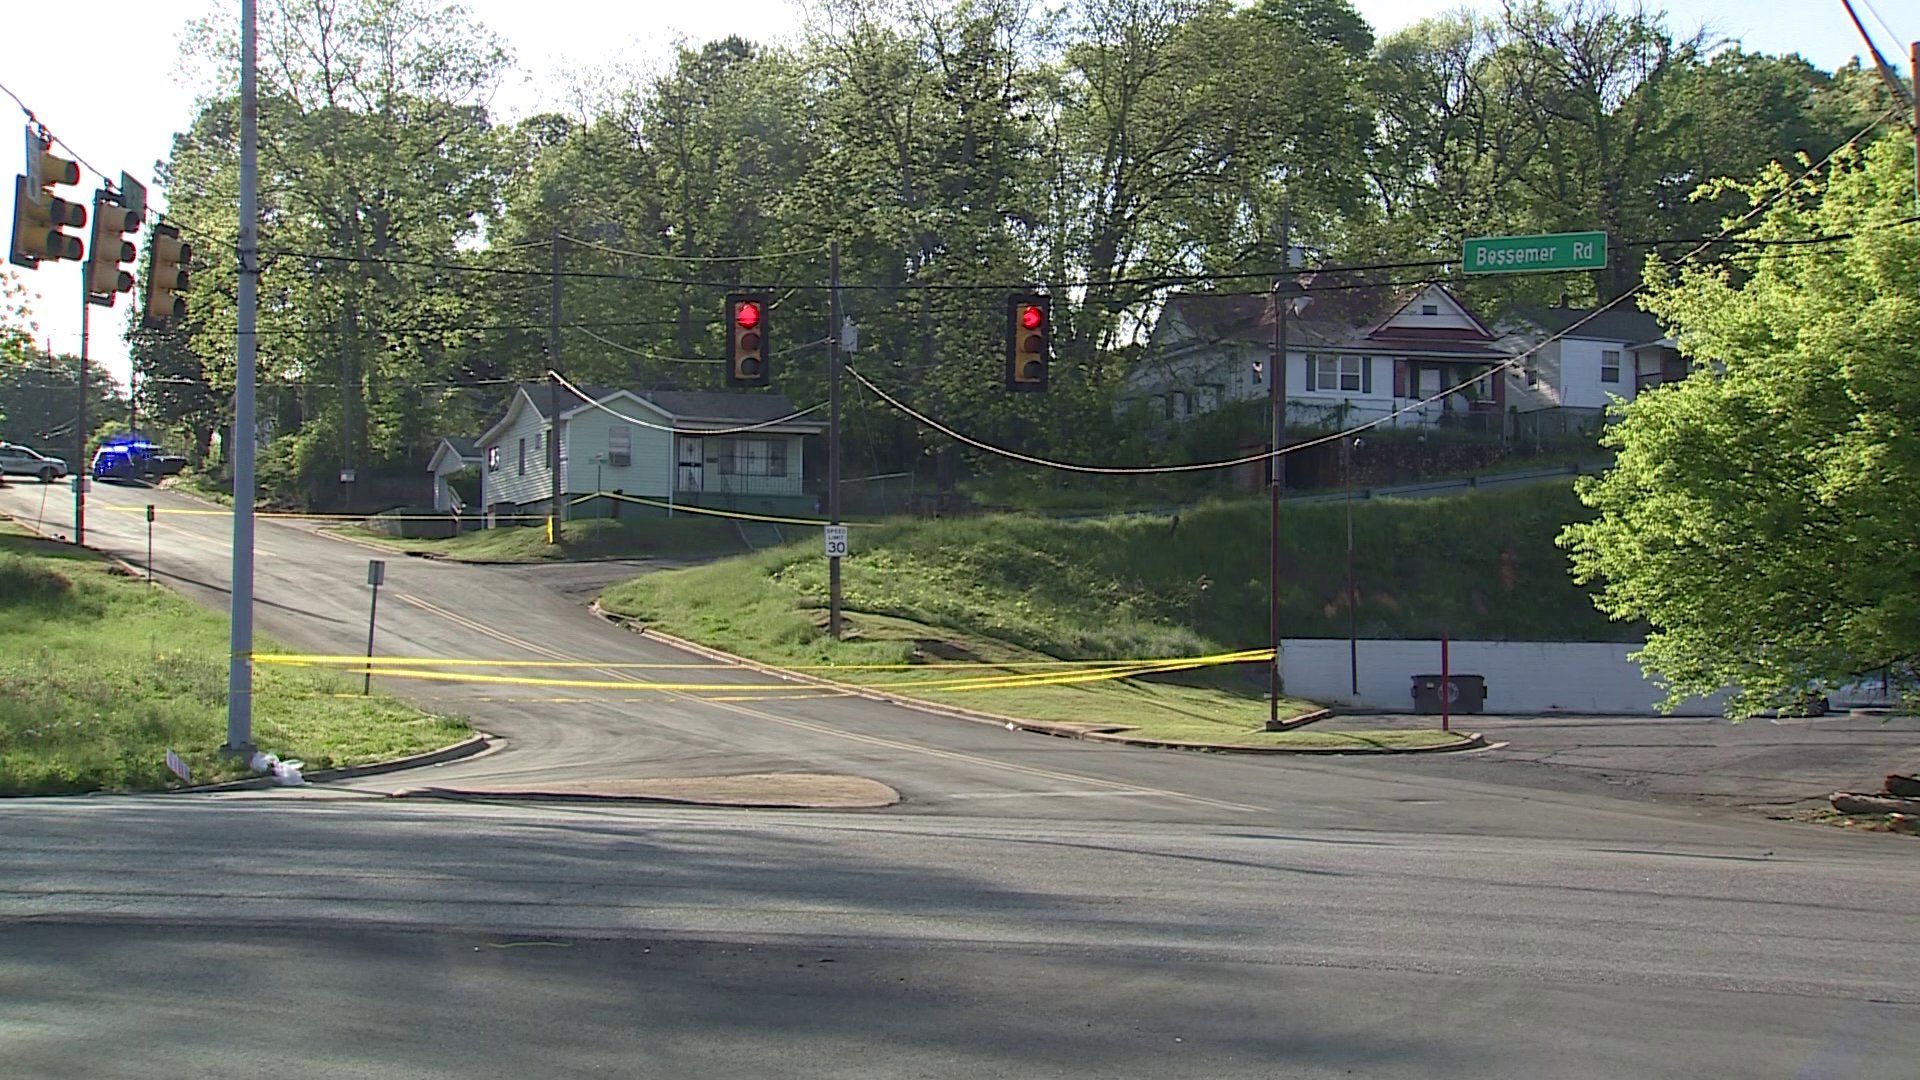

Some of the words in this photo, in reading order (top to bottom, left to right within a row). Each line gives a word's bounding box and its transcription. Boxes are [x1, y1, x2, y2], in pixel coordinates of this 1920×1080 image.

[1476, 246, 1557, 267] Bessemer
[1573, 241, 1593, 261] Rd
[828, 541, 845, 553] 30
